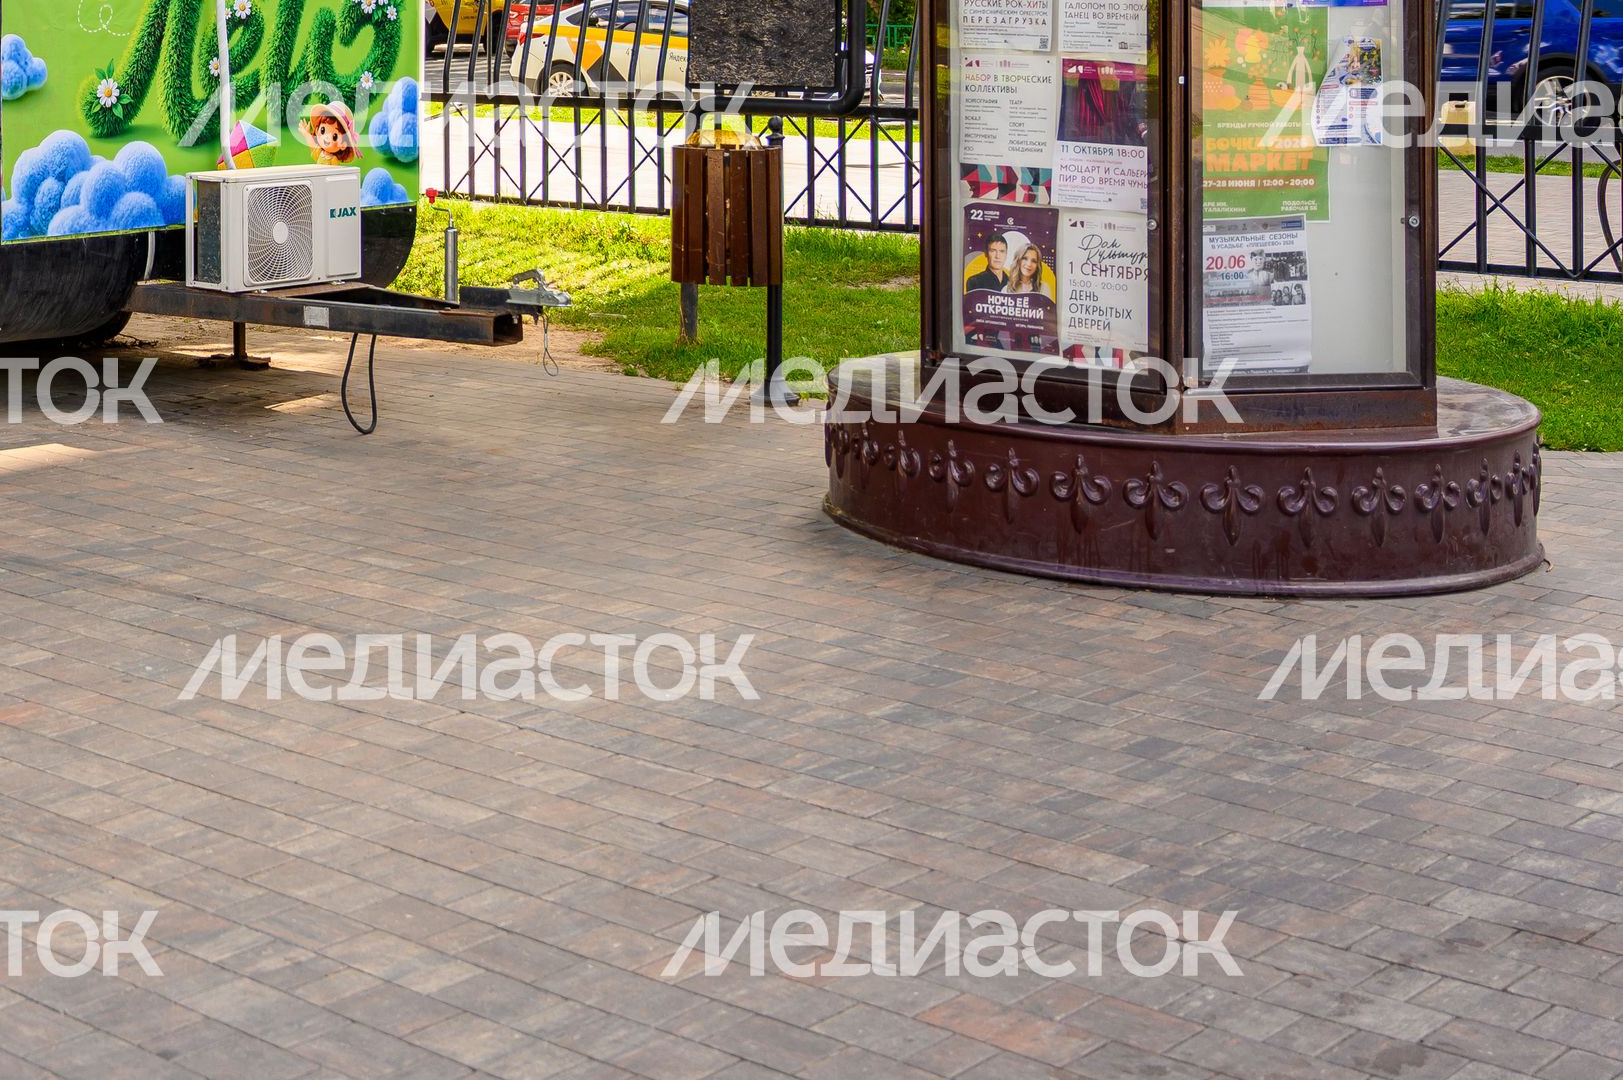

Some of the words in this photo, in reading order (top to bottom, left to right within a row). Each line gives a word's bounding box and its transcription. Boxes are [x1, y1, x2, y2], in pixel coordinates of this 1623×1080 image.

[964, 0, 1002, 8] РУССКИЕ
[1006, 0, 1048, 8] РОК-ХИТЫ
[1064, 2, 1106, 10] ГАЛОПОМ
[1064, 12, 1089, 20] ТАНЕЦ
[1092, 12, 1104, 20] ВО
[1106, 12, 1140, 20] ВРЕМЕНИ
[965, 74, 991, 82] НАБОР
[1002, 75, 1052, 84] ТВОРЧЕСКИЕ
[965, 84, 1018, 94] КОЛЛЕКТИВЫ
[1073, 146, 1114, 156] ОКТЯБРЯ
[1117, 149, 1145, 158] 18:00
[1206, 152, 1314, 172] МАРКЕТ
[1060, 164, 1100, 174] МОЦАРТ
[1059, 174, 1077, 182] ПИР
[1081, 176, 1095, 184] ВО
[1098, 177, 1126, 186] ВРЕМЯ
[1228, 180, 1256, 188] ИЮНЯ
[338, 206, 357, 218] JAX
[970, 210, 983, 220] 22
[1209, 236, 1265, 244] МУЗЫКАЛЬНЫЕ
[1206, 254, 1246, 270] 20.06
[1221, 272, 1244, 280] 16:00
[1070, 280, 1092, 288] 15:00
[1101, 282, 1128, 292] 20:00
[988, 296, 1014, 306] НОЧЬ
[1016, 297, 1030, 308] ЕЁ
[1069, 290, 1098, 302] ДЕНЬ
[976, 304, 1044, 320] ОТКРОВЕНИЙ
[1068, 303, 1132, 320] ОТКРЫТЫХ
[1068, 316, 1111, 331] ДВЕРЕЙ
